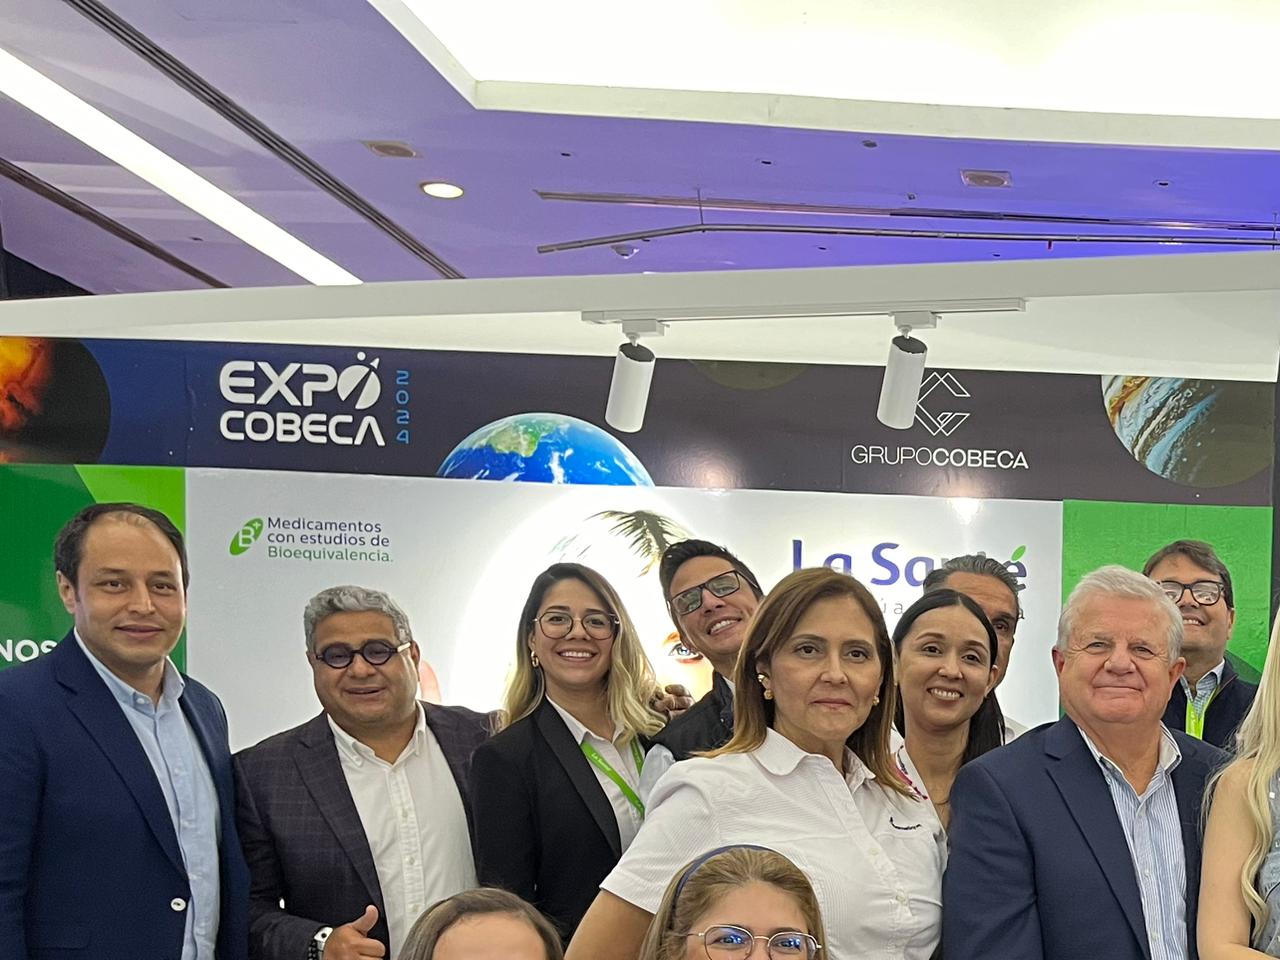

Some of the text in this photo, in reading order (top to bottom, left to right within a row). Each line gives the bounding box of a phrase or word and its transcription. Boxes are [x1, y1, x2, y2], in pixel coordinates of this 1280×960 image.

[219, 410, 386, 447] COBECA
[267, 517, 382, 533] Medicamentos
[267, 533, 390, 547] con estudios de
[870, 542, 1028, 591] Saé
